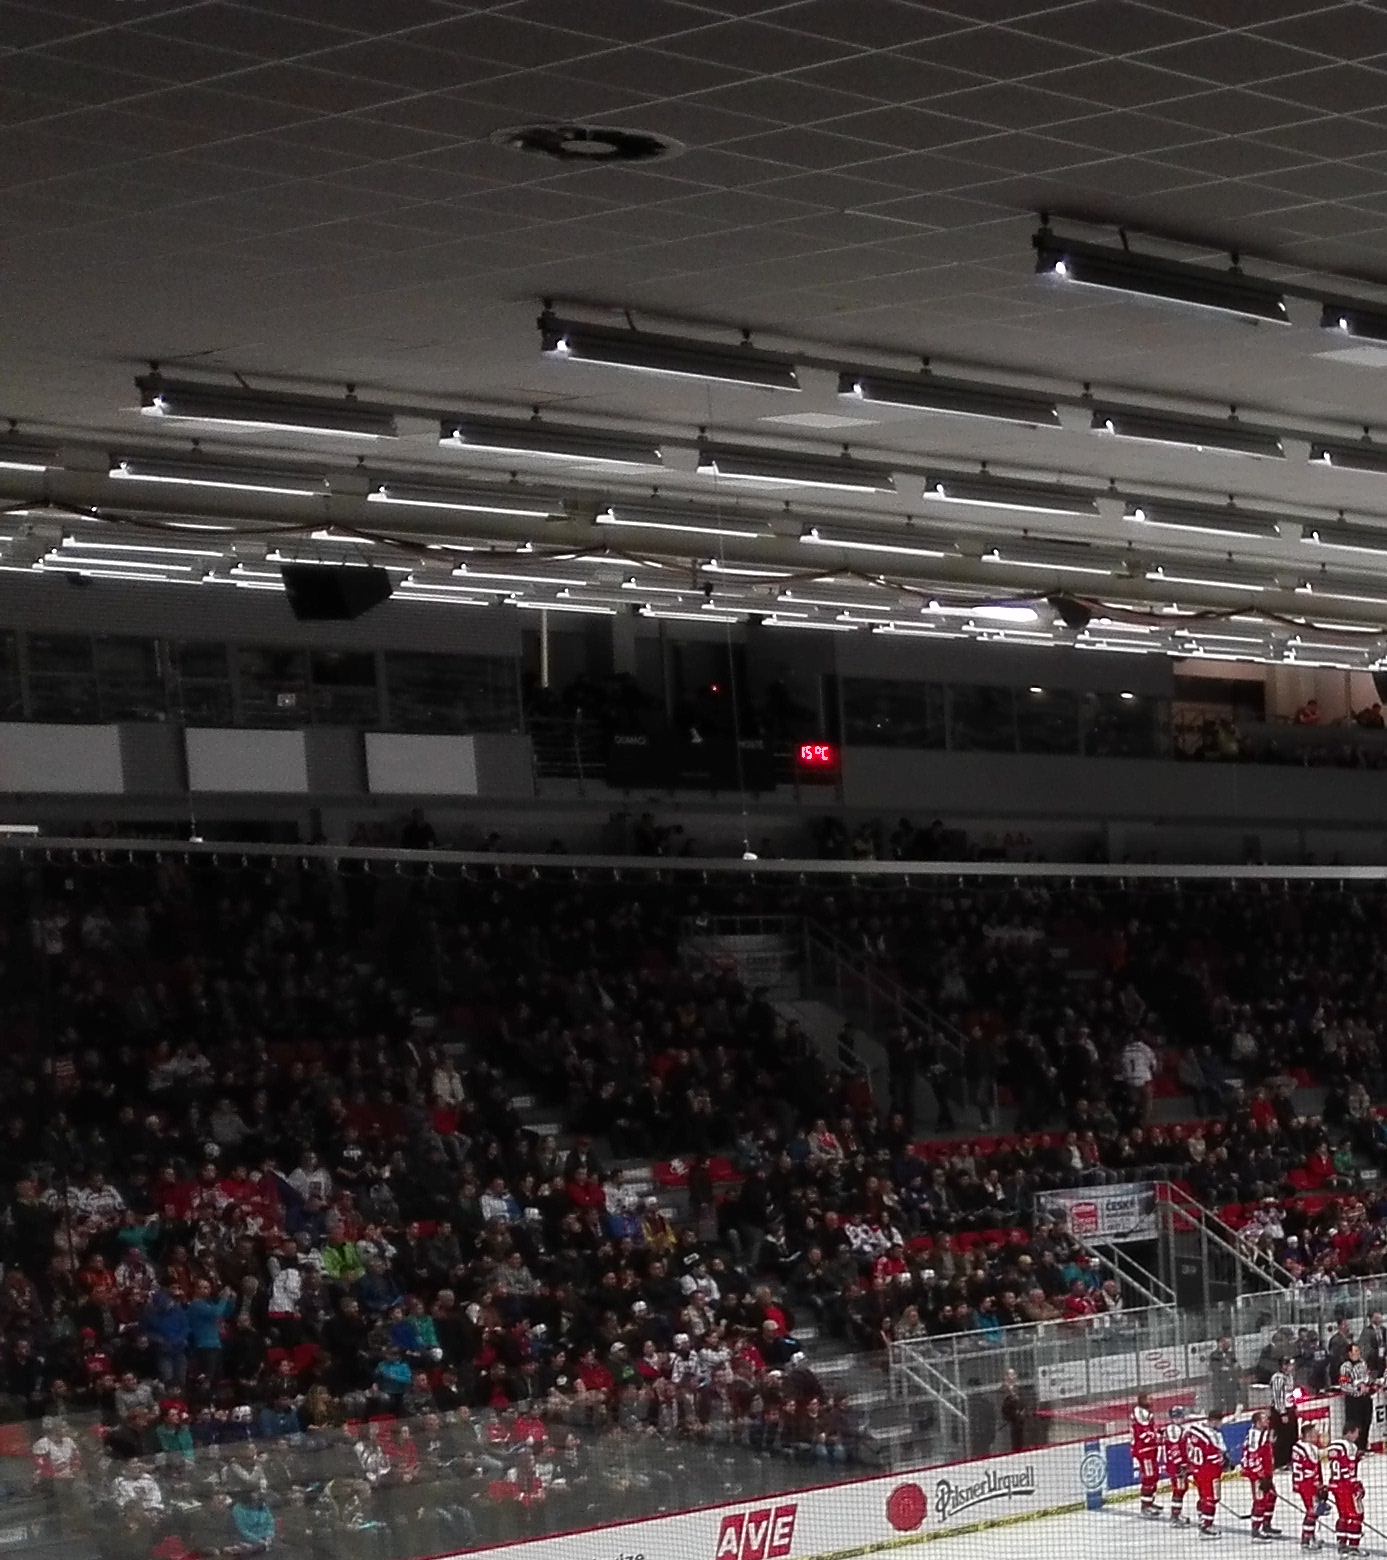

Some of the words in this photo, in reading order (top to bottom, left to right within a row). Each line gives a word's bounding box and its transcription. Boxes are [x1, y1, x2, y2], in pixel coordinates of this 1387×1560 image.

[935, 1478, 988, 1523] Pilsner
[986, 1466, 1036, 1497] Urquell
[716, 1511, 796, 1559] AVE
